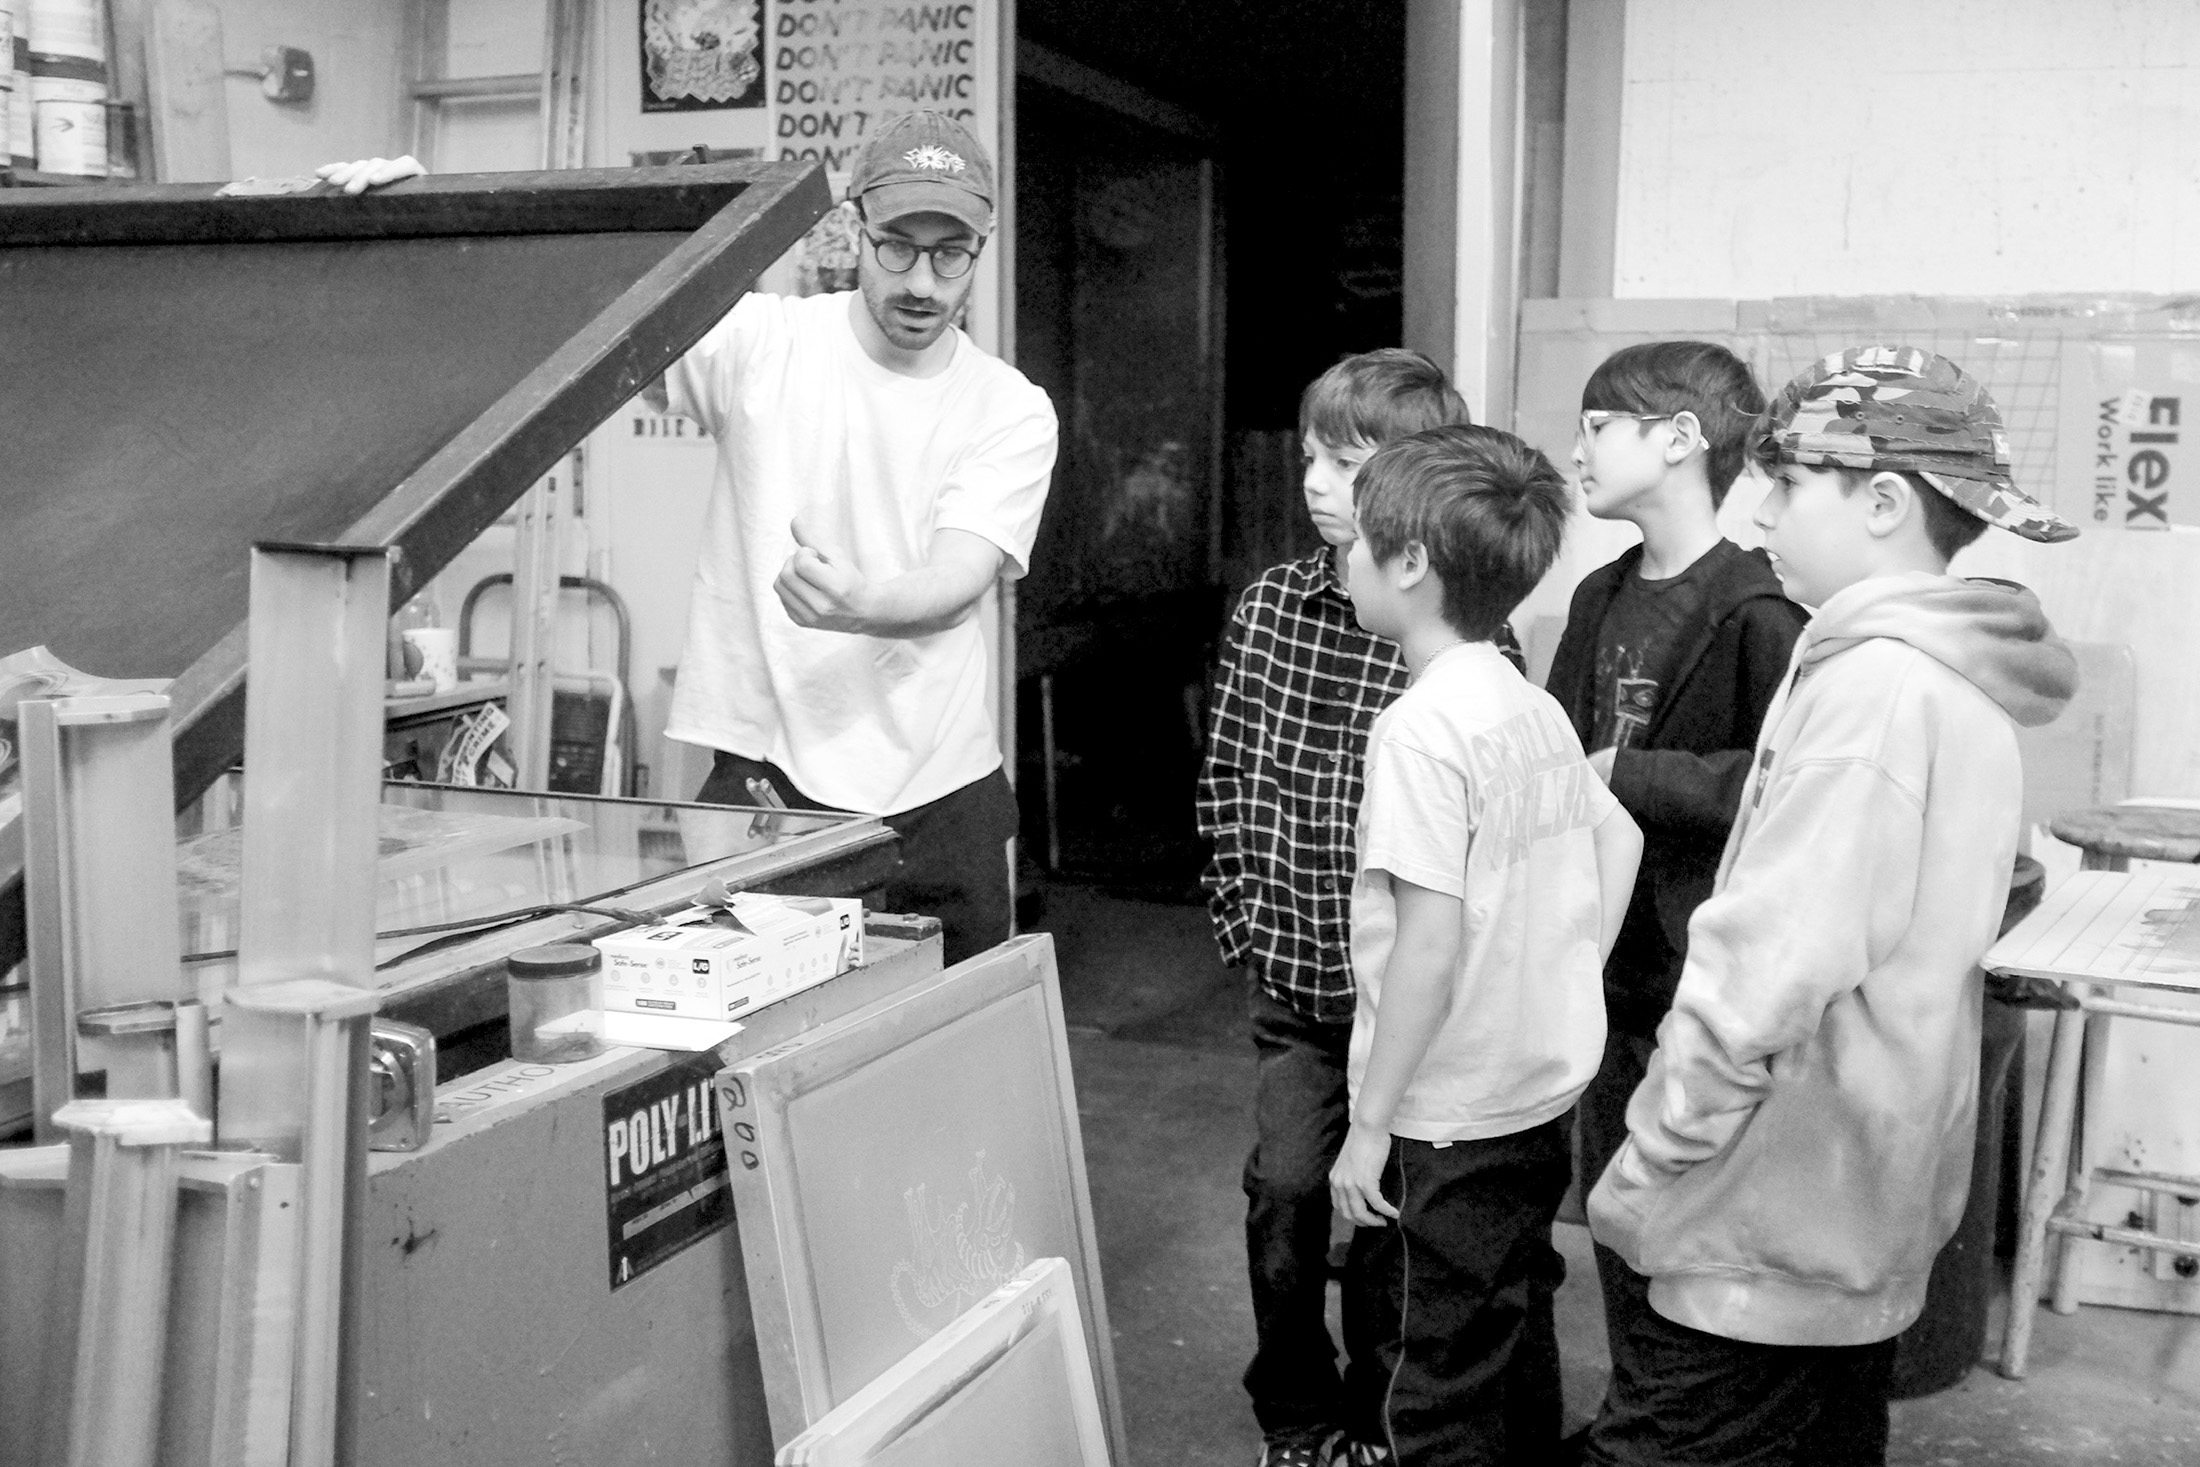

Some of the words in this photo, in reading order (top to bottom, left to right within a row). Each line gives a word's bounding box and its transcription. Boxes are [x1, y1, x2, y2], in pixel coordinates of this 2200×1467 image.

[879, 4, 974, 34] PANIC
[878, 73, 974, 102] PANIC
[777, 110, 869, 139] DON'T
[2097, 397, 2119, 467] Work
[2094, 476, 2117, 521] like
[438, 1064, 567, 1109] AUTHO
